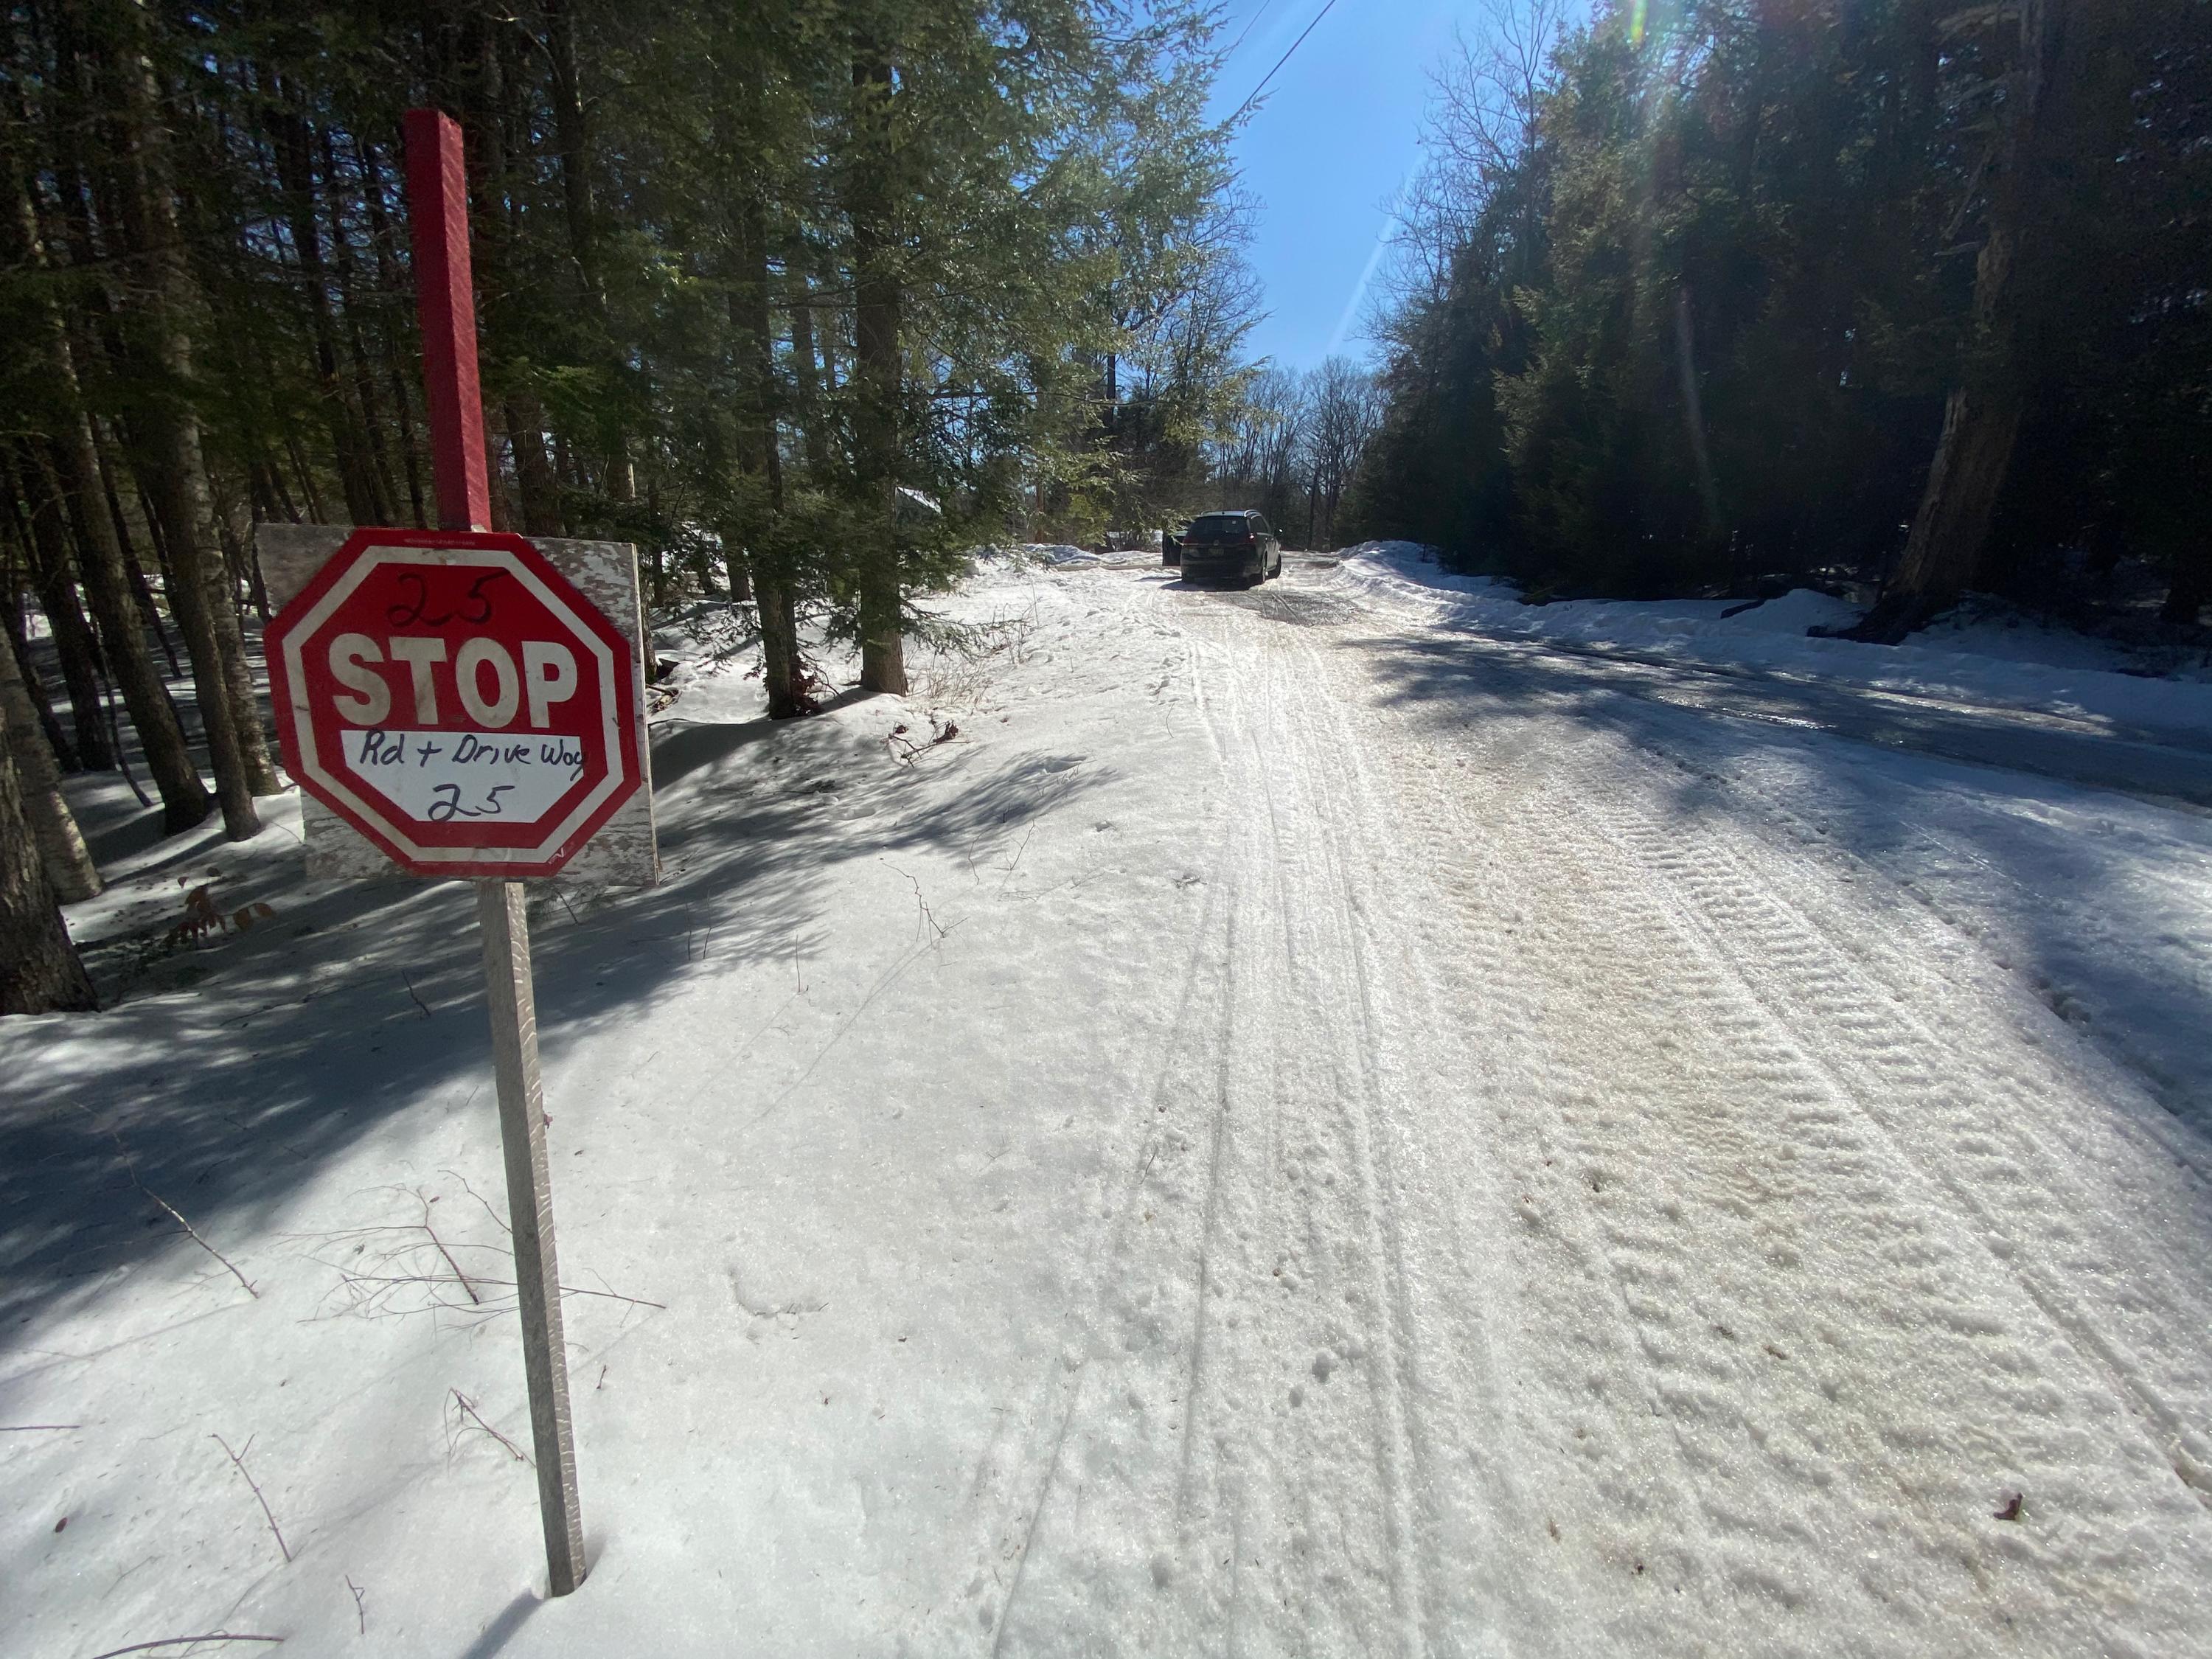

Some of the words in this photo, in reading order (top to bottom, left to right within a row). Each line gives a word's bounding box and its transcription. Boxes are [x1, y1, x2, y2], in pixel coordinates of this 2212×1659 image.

[386, 570, 510, 627] 25
[329, 633, 578, 728] STOP
[359, 729, 405, 765] Rd
[417, 741, 442, 768] +
[428, 783, 515, 821] 25
